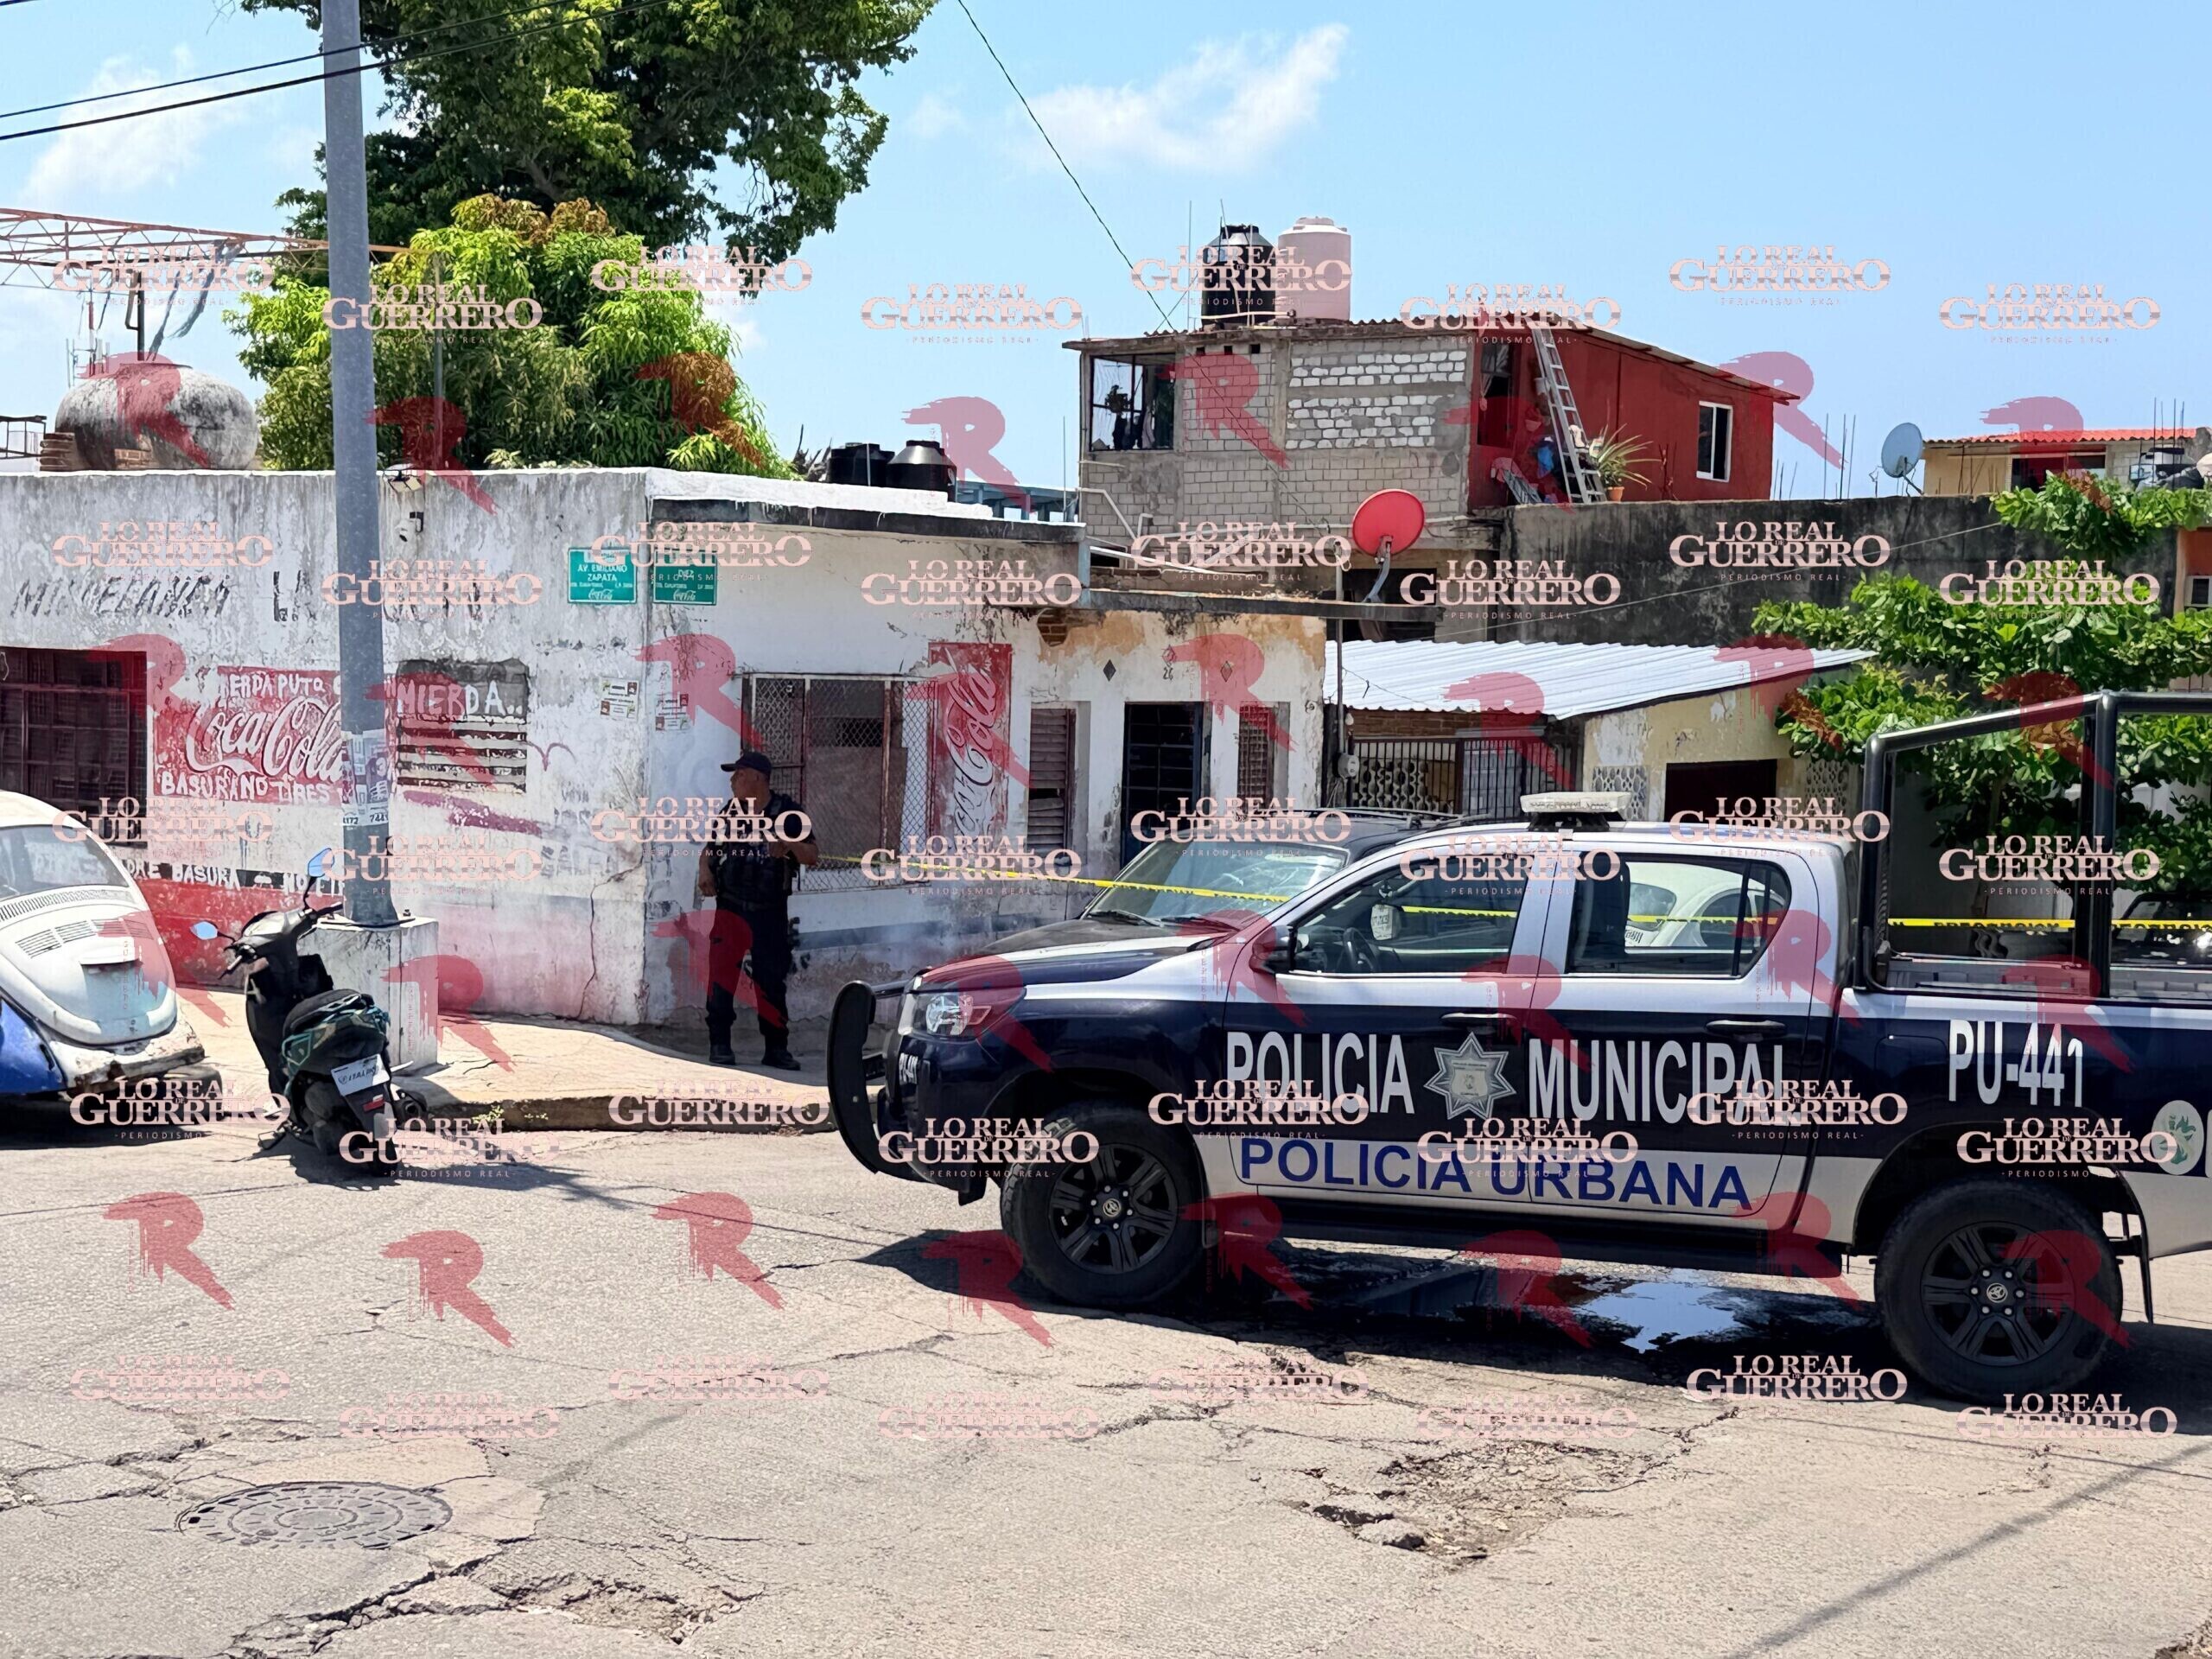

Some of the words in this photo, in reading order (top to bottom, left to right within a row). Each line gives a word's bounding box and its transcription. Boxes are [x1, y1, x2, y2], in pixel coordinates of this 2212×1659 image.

[588, 573, 618, 582] ZAPATA
[1226, 1031, 1414, 1114] POLICIA
[1528, 1039, 1802, 1127] MUNICIPAL
[1949, 1019, 2083, 1108] PU-441
[1241, 1137, 1472, 1194] POLICIA
[1491, 1150, 1753, 1210] URBANA
